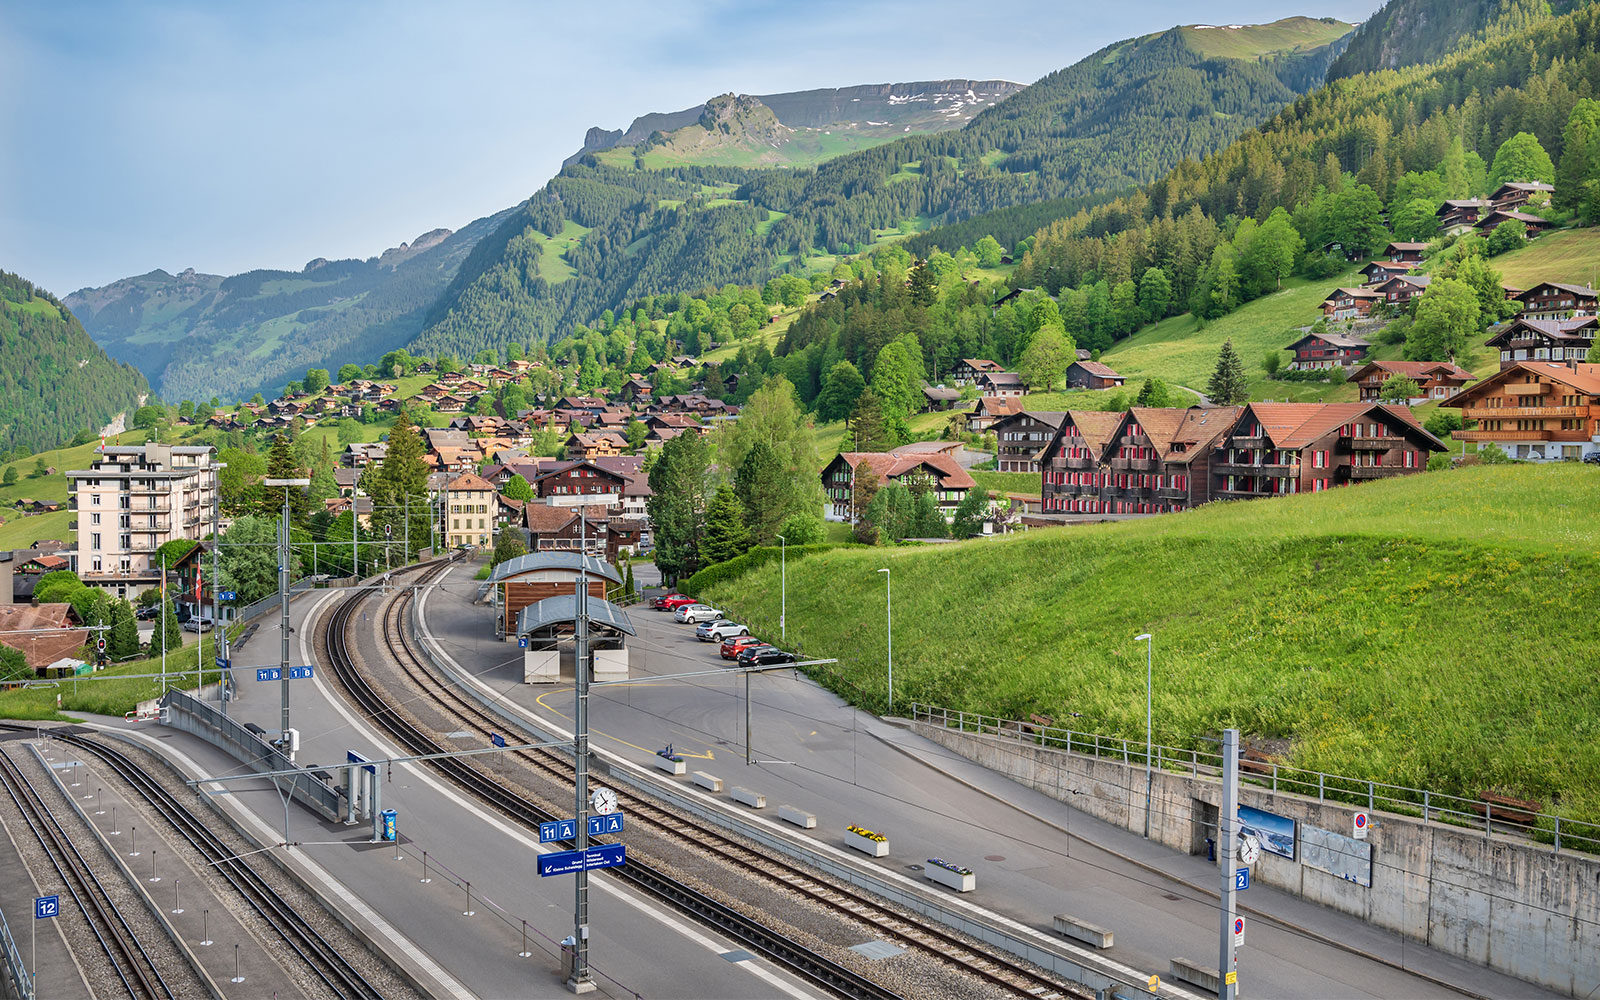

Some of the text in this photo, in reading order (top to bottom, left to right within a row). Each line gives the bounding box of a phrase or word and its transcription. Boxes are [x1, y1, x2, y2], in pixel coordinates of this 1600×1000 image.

[594, 820, 619, 832] 1 A
[544, 826, 572, 839] 11 A
[1238, 875, 1245, 887] 2
[40, 903, 55, 914] 12
